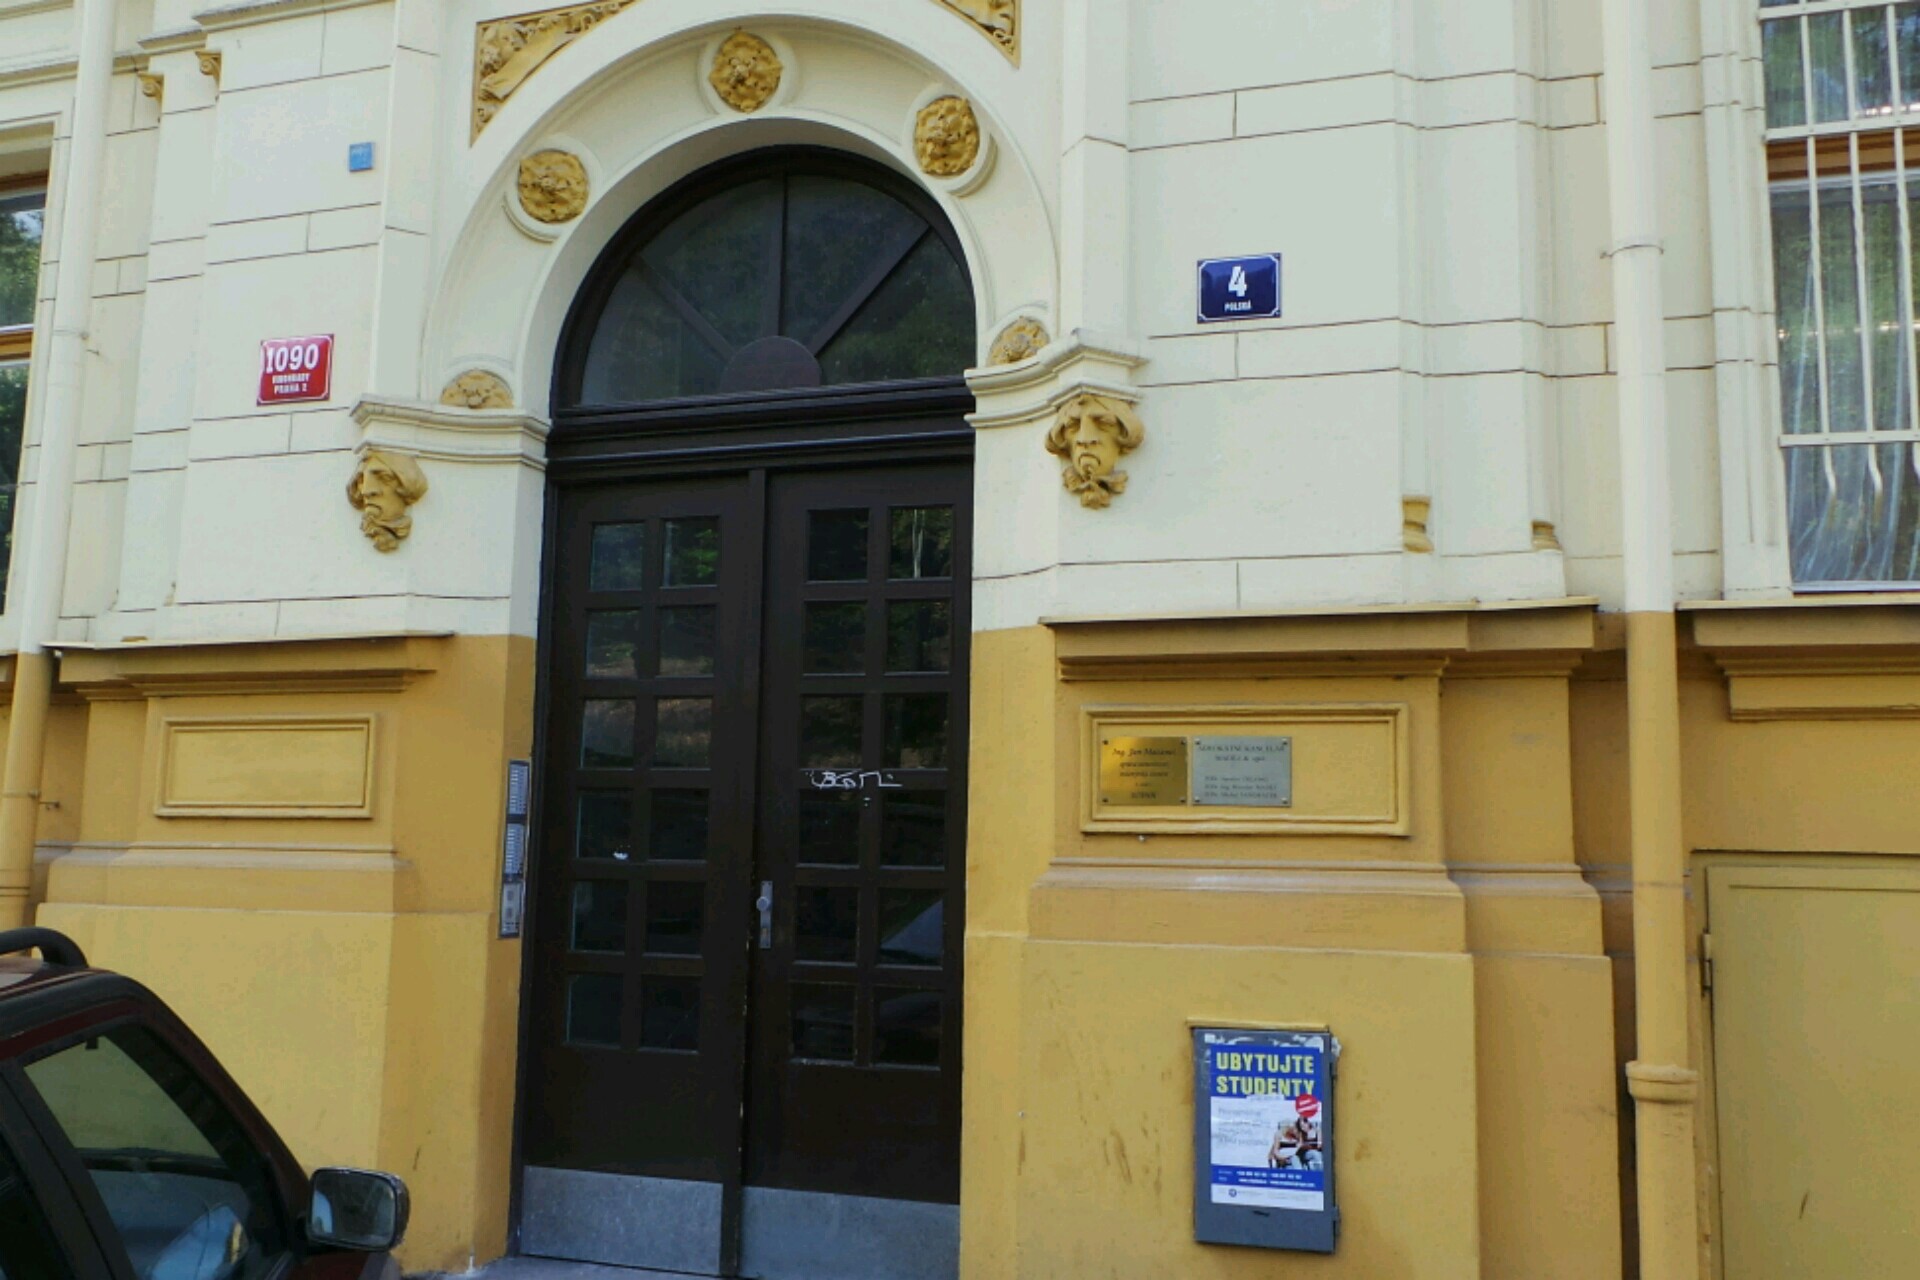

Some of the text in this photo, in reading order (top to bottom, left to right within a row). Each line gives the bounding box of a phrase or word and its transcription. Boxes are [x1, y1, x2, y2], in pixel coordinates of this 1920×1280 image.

[1228, 265, 1247, 297] 4
[1225, 300, 1251, 312] POLSKÁ
[266, 344, 318, 373] 1090
[274, 383, 307, 395] PRAHA 2
[1216, 1052, 1314, 1074] UBYTUJTE
[1216, 1075, 1315, 1097] STUDENTY
